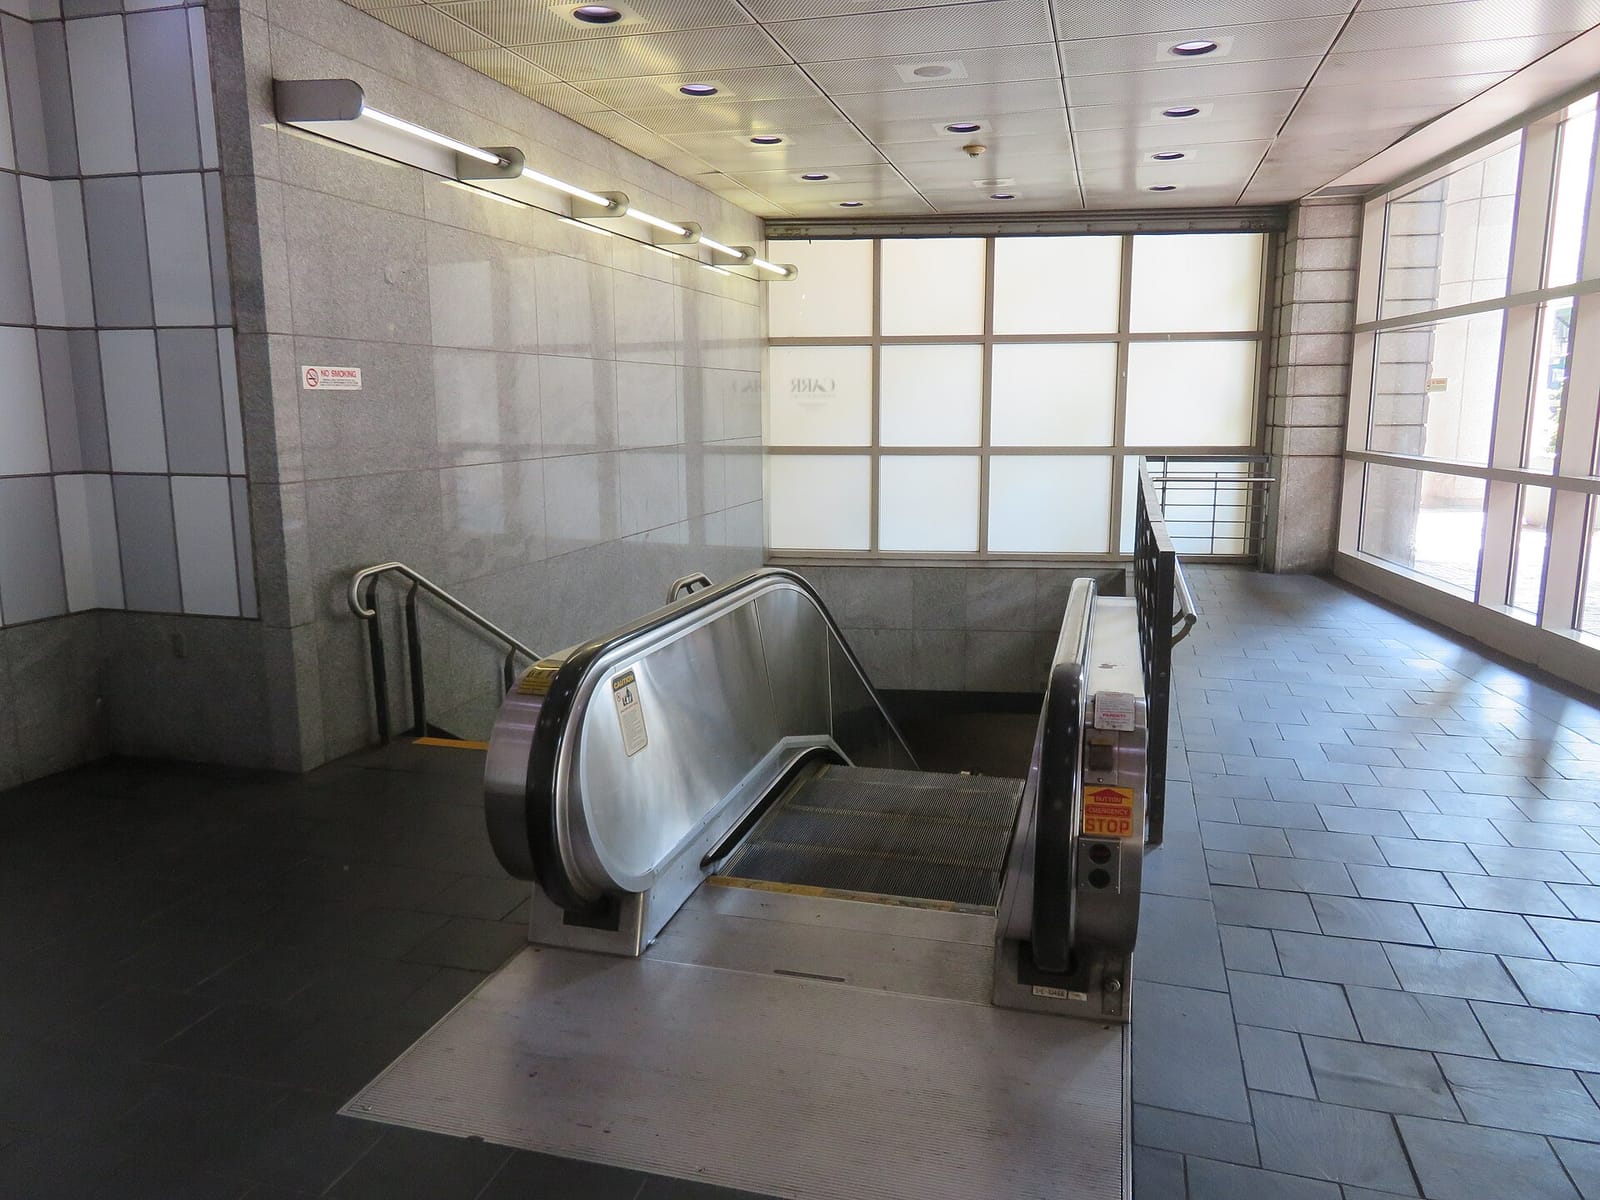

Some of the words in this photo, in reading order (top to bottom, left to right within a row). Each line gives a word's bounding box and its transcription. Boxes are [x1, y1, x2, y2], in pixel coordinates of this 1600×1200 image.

[613, 675, 634, 689] CAUTION
[1088, 806, 1129, 816] EMERGENCY
[1087, 818, 1129, 834] STOP
